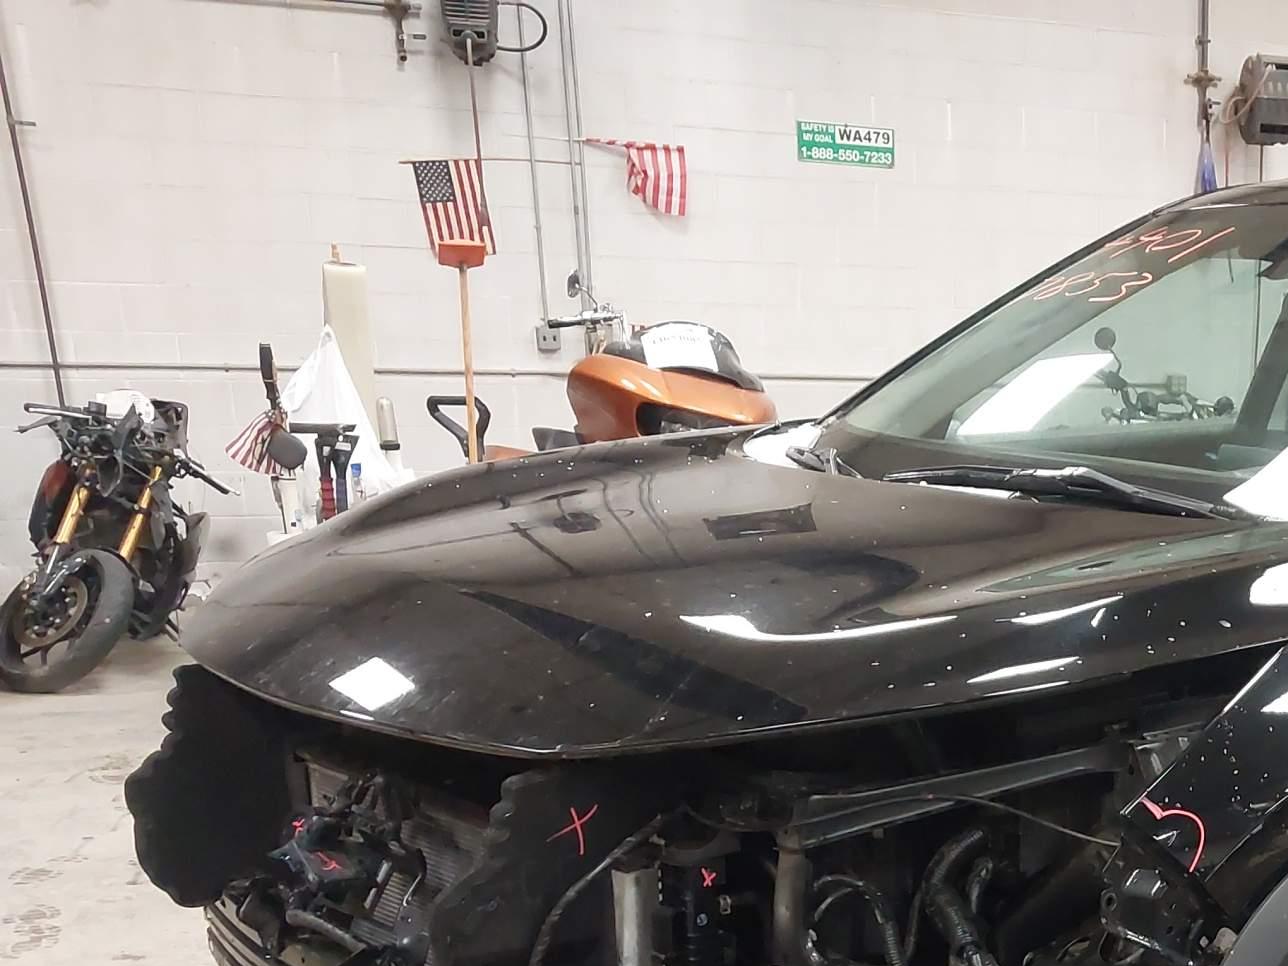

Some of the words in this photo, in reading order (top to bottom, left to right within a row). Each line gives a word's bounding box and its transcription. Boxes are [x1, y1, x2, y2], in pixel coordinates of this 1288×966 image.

[801, 122, 826, 132] SAFETY
[814, 133, 833, 144] GOAL
[838, 127, 890, 145] WA479
[800, 146, 892, 165] 1-888-550-7233
